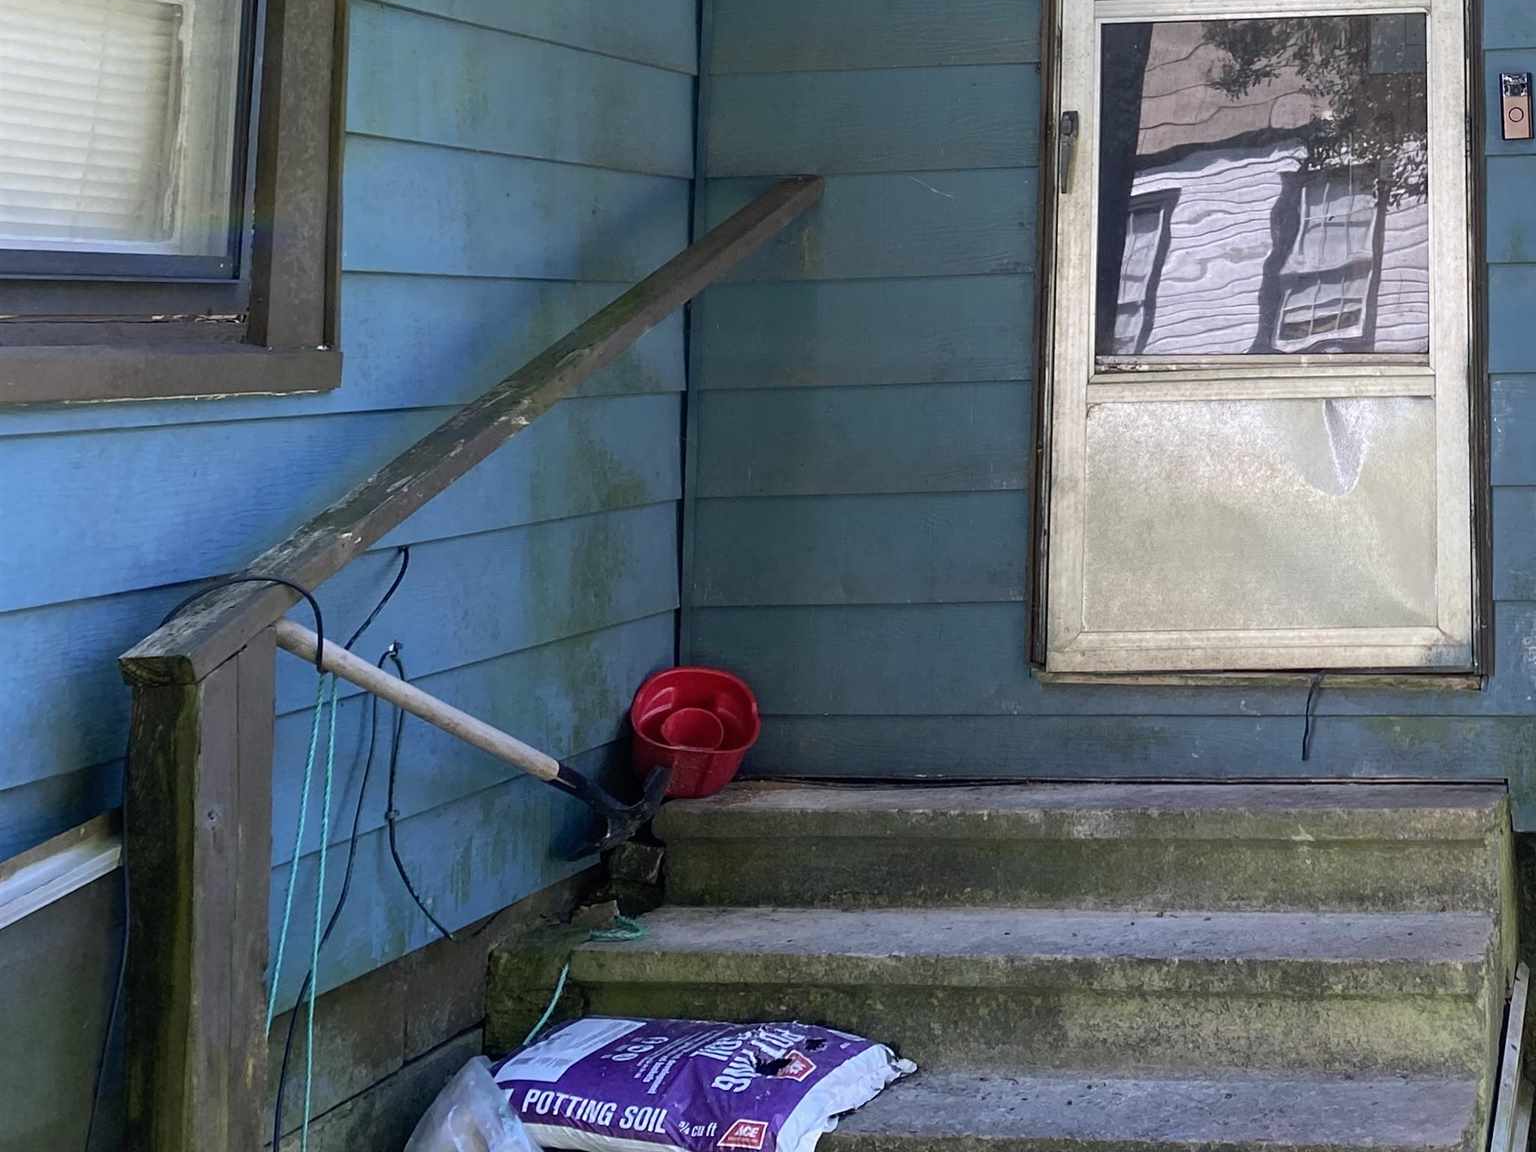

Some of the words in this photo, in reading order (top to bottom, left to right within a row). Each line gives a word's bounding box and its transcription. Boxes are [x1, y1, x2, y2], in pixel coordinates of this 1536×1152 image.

[521, 1088, 618, 1127] POTTING
[619, 1104, 668, 1134] SOIL
[691, 1124, 705, 1137] cu
[706, 1122, 718, 1137] ft
[734, 1124, 760, 1138] ACE
